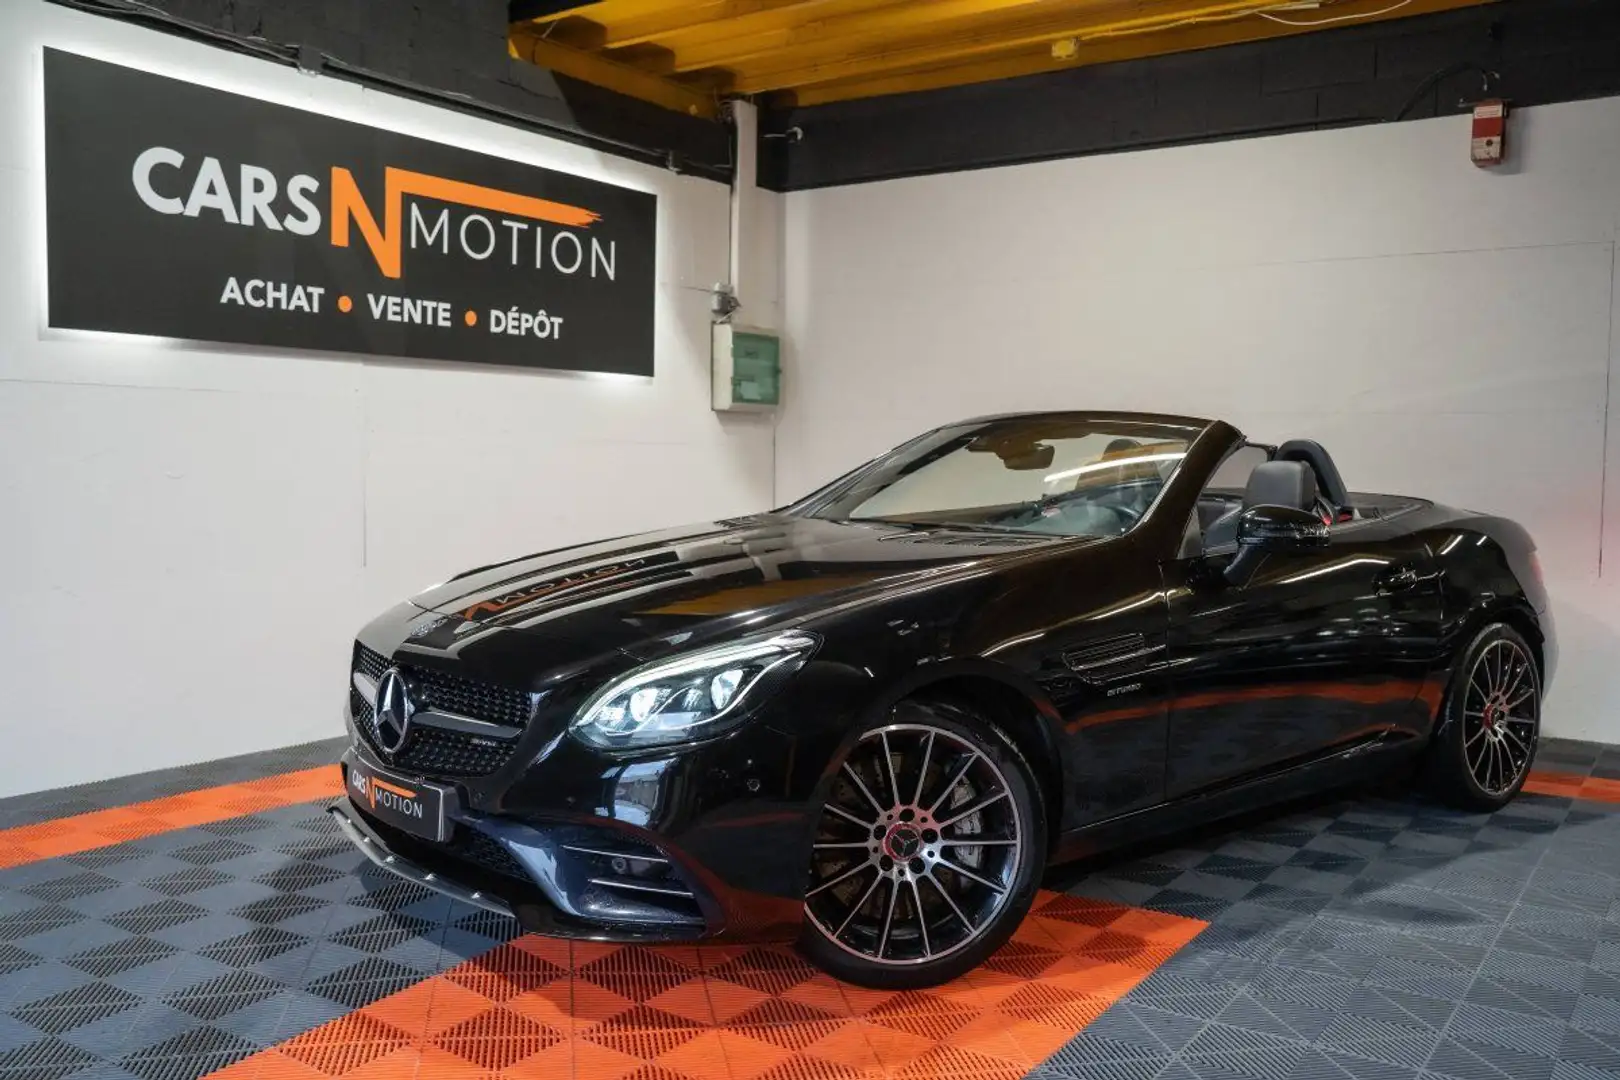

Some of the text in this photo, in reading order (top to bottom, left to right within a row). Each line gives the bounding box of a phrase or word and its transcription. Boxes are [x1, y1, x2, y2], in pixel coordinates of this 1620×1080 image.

[220, 276, 564, 340] ACHAT VENTE DÉPÔT
